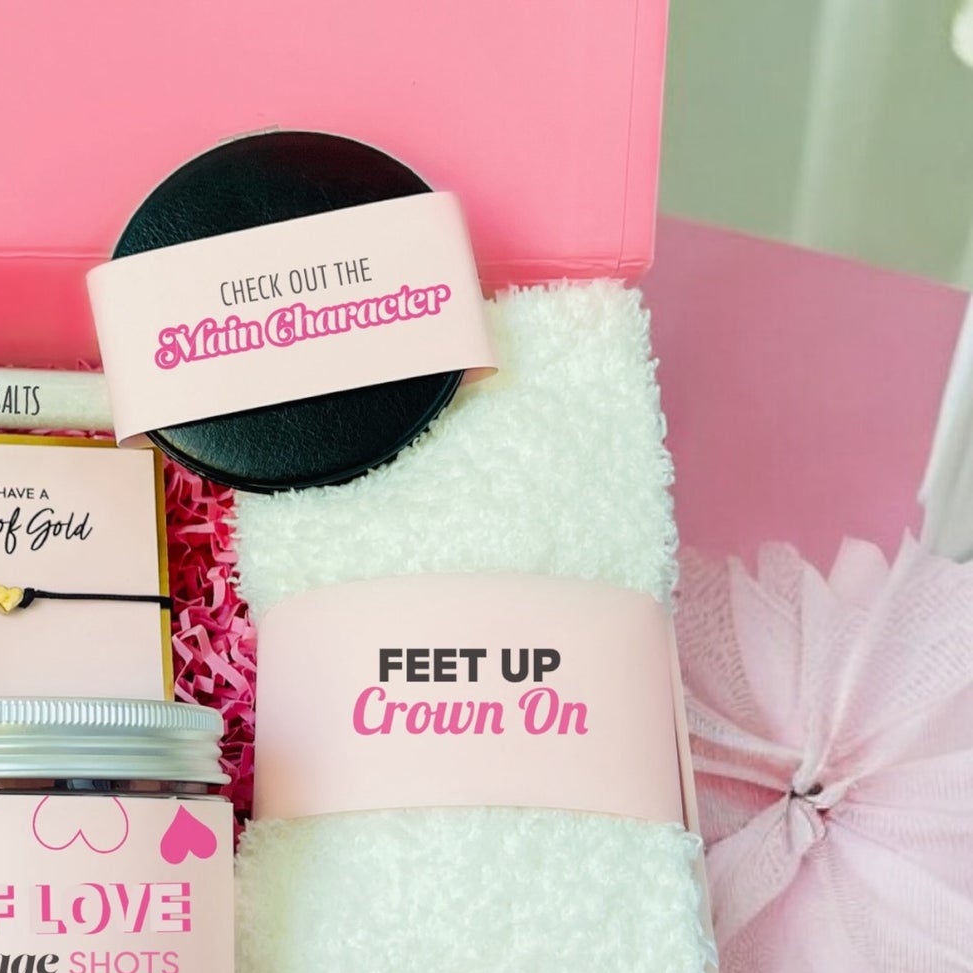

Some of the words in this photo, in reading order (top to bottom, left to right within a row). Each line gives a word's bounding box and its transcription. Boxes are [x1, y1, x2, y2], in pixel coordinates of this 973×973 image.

[220, 273, 283, 306] CHECK
[289, 264, 327, 294] OUT
[333, 257, 372, 287] THE
[154, 314, 265, 369] Main
[265, 284, 451, 348] Character
[39, 488, 49, 500] A
[26, 508, 93, 551] Gold
[379, 647, 487, 683] FEET
[501, 647, 561, 683] UP
[352, 686, 505, 736] Crown
[518, 687, 588, 736] On
[30, 881, 192, 936] LOVE
